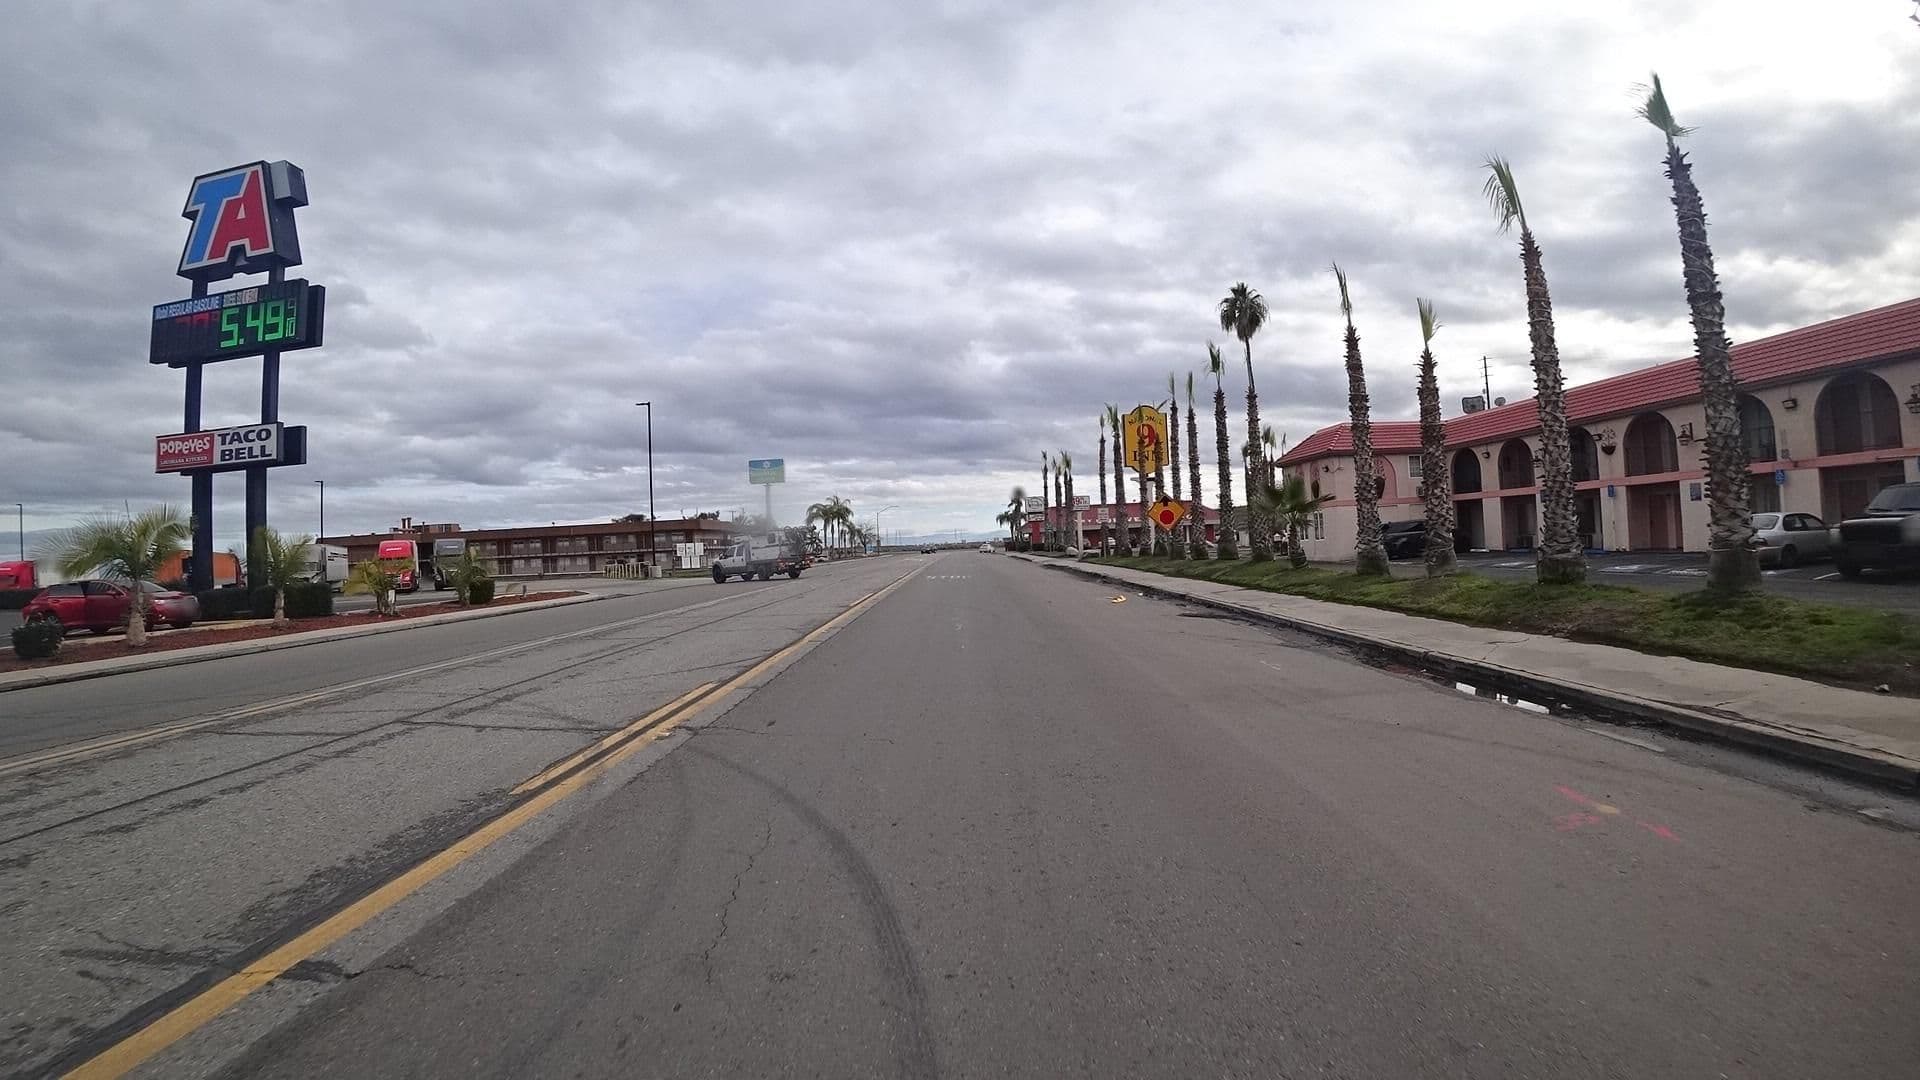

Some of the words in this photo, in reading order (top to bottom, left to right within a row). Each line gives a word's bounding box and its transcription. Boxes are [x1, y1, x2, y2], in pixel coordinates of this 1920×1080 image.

[181, 164, 274, 271] TA
[220, 300, 285, 348] 5.49
[217, 428, 272, 446] TACO
[1136, 423, 1156, 448] 9
[220, 445, 273, 462] BELL
